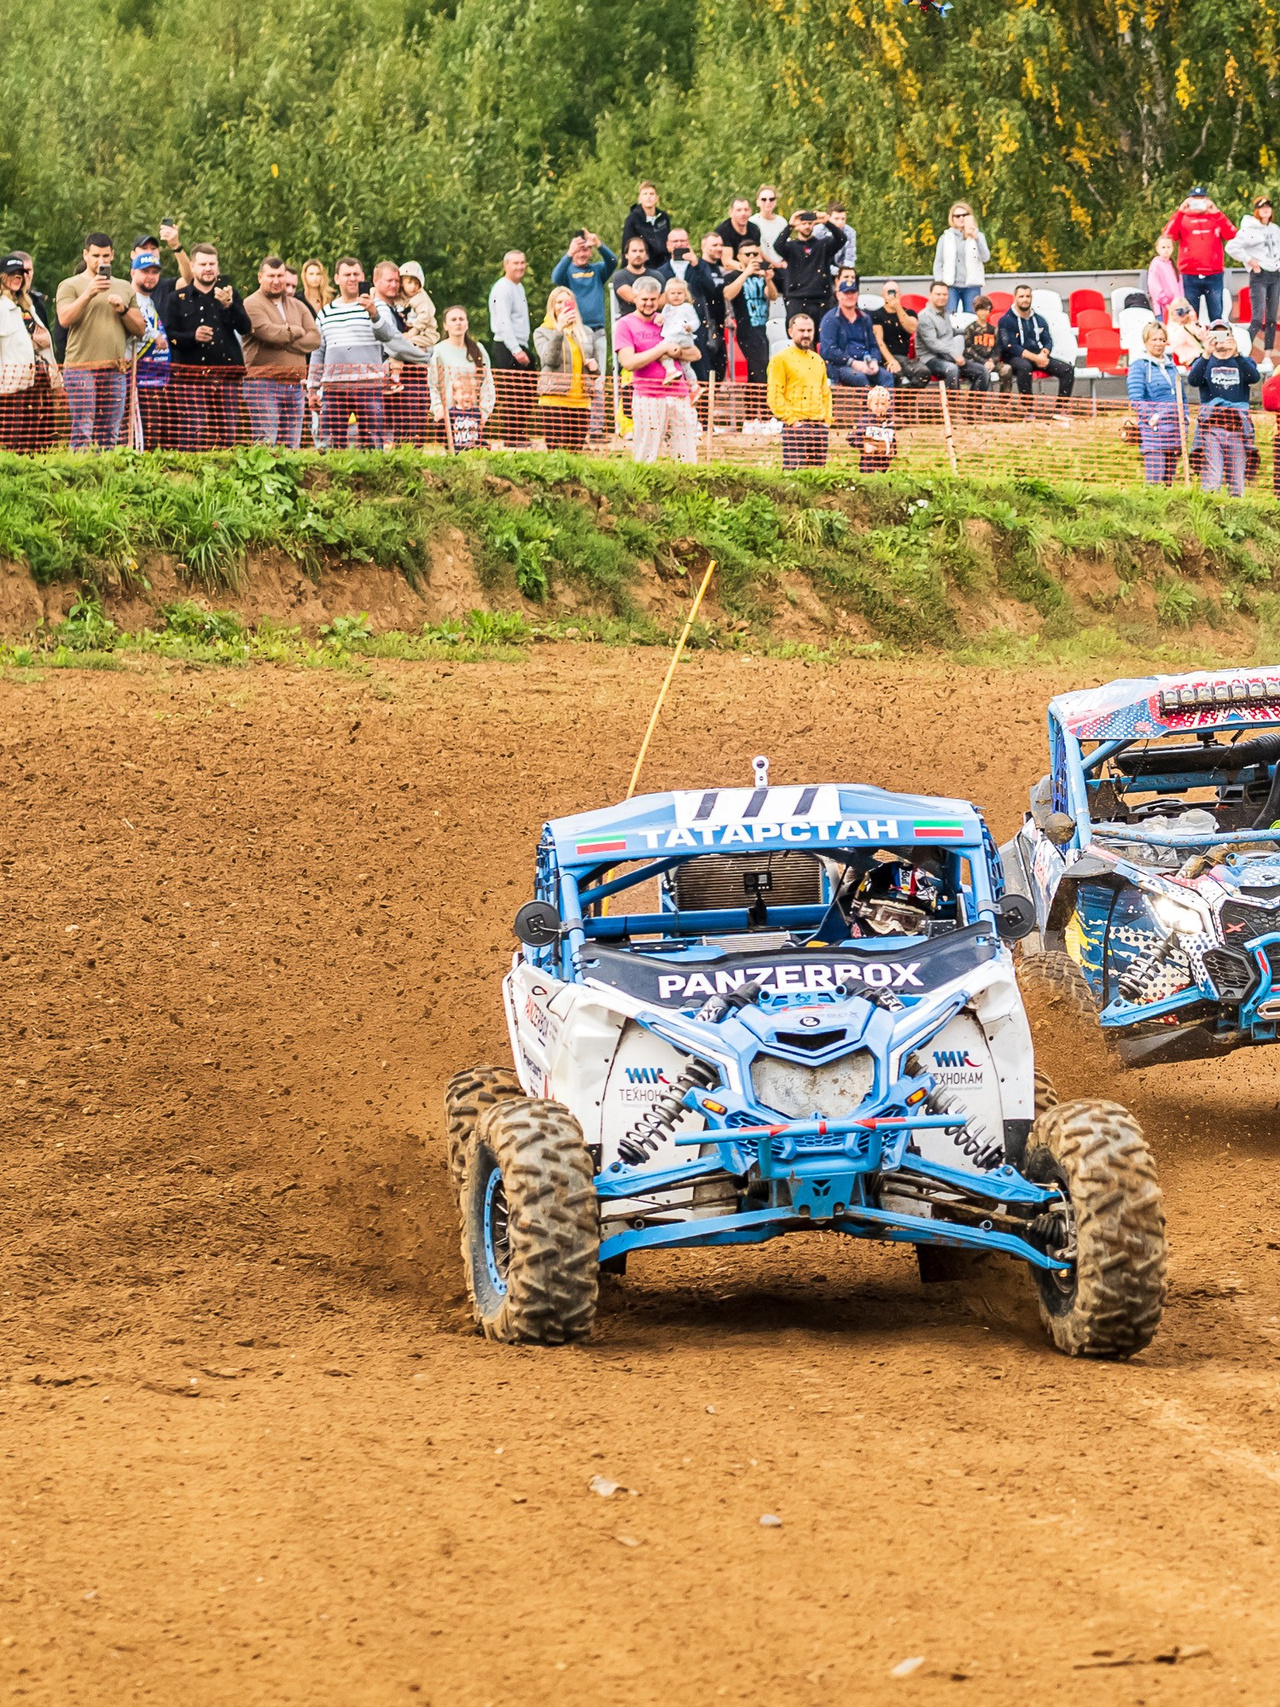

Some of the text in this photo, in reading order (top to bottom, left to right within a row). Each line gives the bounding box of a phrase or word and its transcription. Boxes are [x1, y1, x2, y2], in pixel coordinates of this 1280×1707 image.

[638, 820, 899, 848] ТАТАРСТАН
[658, 962, 924, 999] PANZERBOX
[932, 1072, 983, 1085] ЕХНОКАМ
